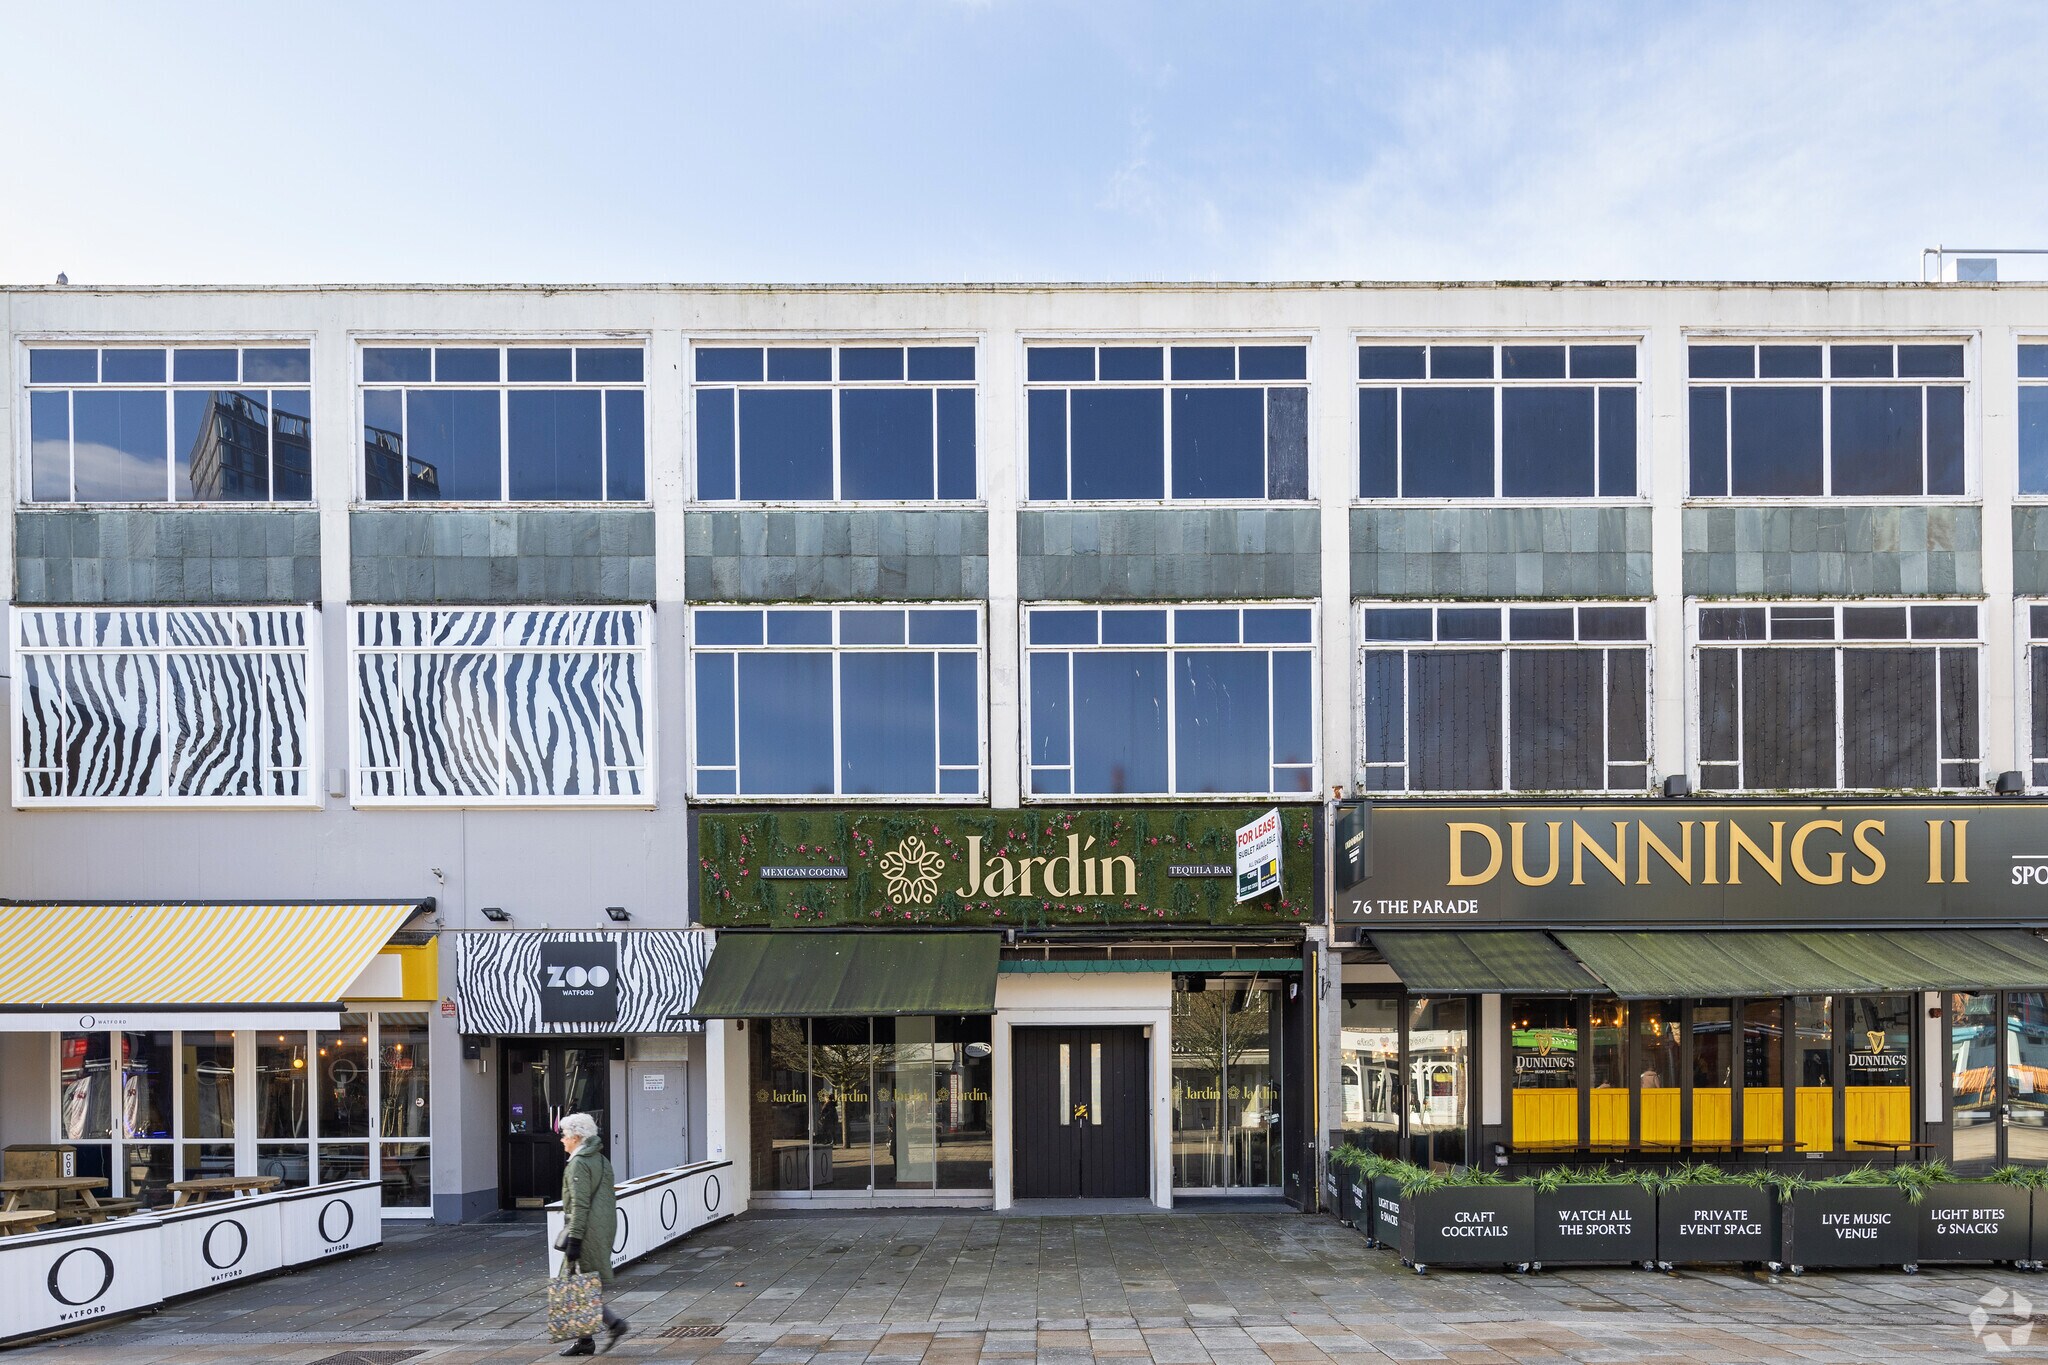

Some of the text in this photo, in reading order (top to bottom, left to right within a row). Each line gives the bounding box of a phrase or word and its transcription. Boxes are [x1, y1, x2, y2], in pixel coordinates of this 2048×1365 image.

[1238, 816, 1275, 847] FOR LEASE
[1238, 833, 1276, 859] SUBLET AVAILABLE
[1446, 819, 1971, 886] DUNNINGS II
[955, 833, 1138, 898] Jardín
[1170, 866, 1232, 876] TEQUILA BAR
[762, 868, 846, 876] MEXICAN COCINA
[1352, 900, 1479, 914] 76 THE PARADE
[547, 965, 610, 988] ZOO
[1515, 1055, 1575, 1068] DUNNING'S
[1848, 1053, 1907, 1066] DUNNING'S
[771, 1089, 807, 1103] Jardín
[831, 1088, 868, 1103] Jardín
[1185, 1086, 1221, 1101] Jardín
[1454, 1211, 1495, 1222] CRAFT
[1558, 1210, 1632, 1221] WATCH ALL
[1694, 1210, 1748, 1221] PRIVATE
[1822, 1213, 1891, 1225] LIVE MUSIC
[1931, 1209, 2005, 1220] LIGHT BITES
[1441, 1226, 1509, 1237] COCKTAILS
[1559, 1224, 1631, 1235] THE SPORTS
[1680, 1224, 1762, 1235] EVENT SPACE
[1835, 1228, 1878, 1239] VENUE
[1937, 1223, 1999, 1234] & SNACKS
[324, 1243, 349, 1254] WATFORD
[211, 1269, 243, 1282] WATFORD
[60, 1305, 107, 1321] WATFORD
